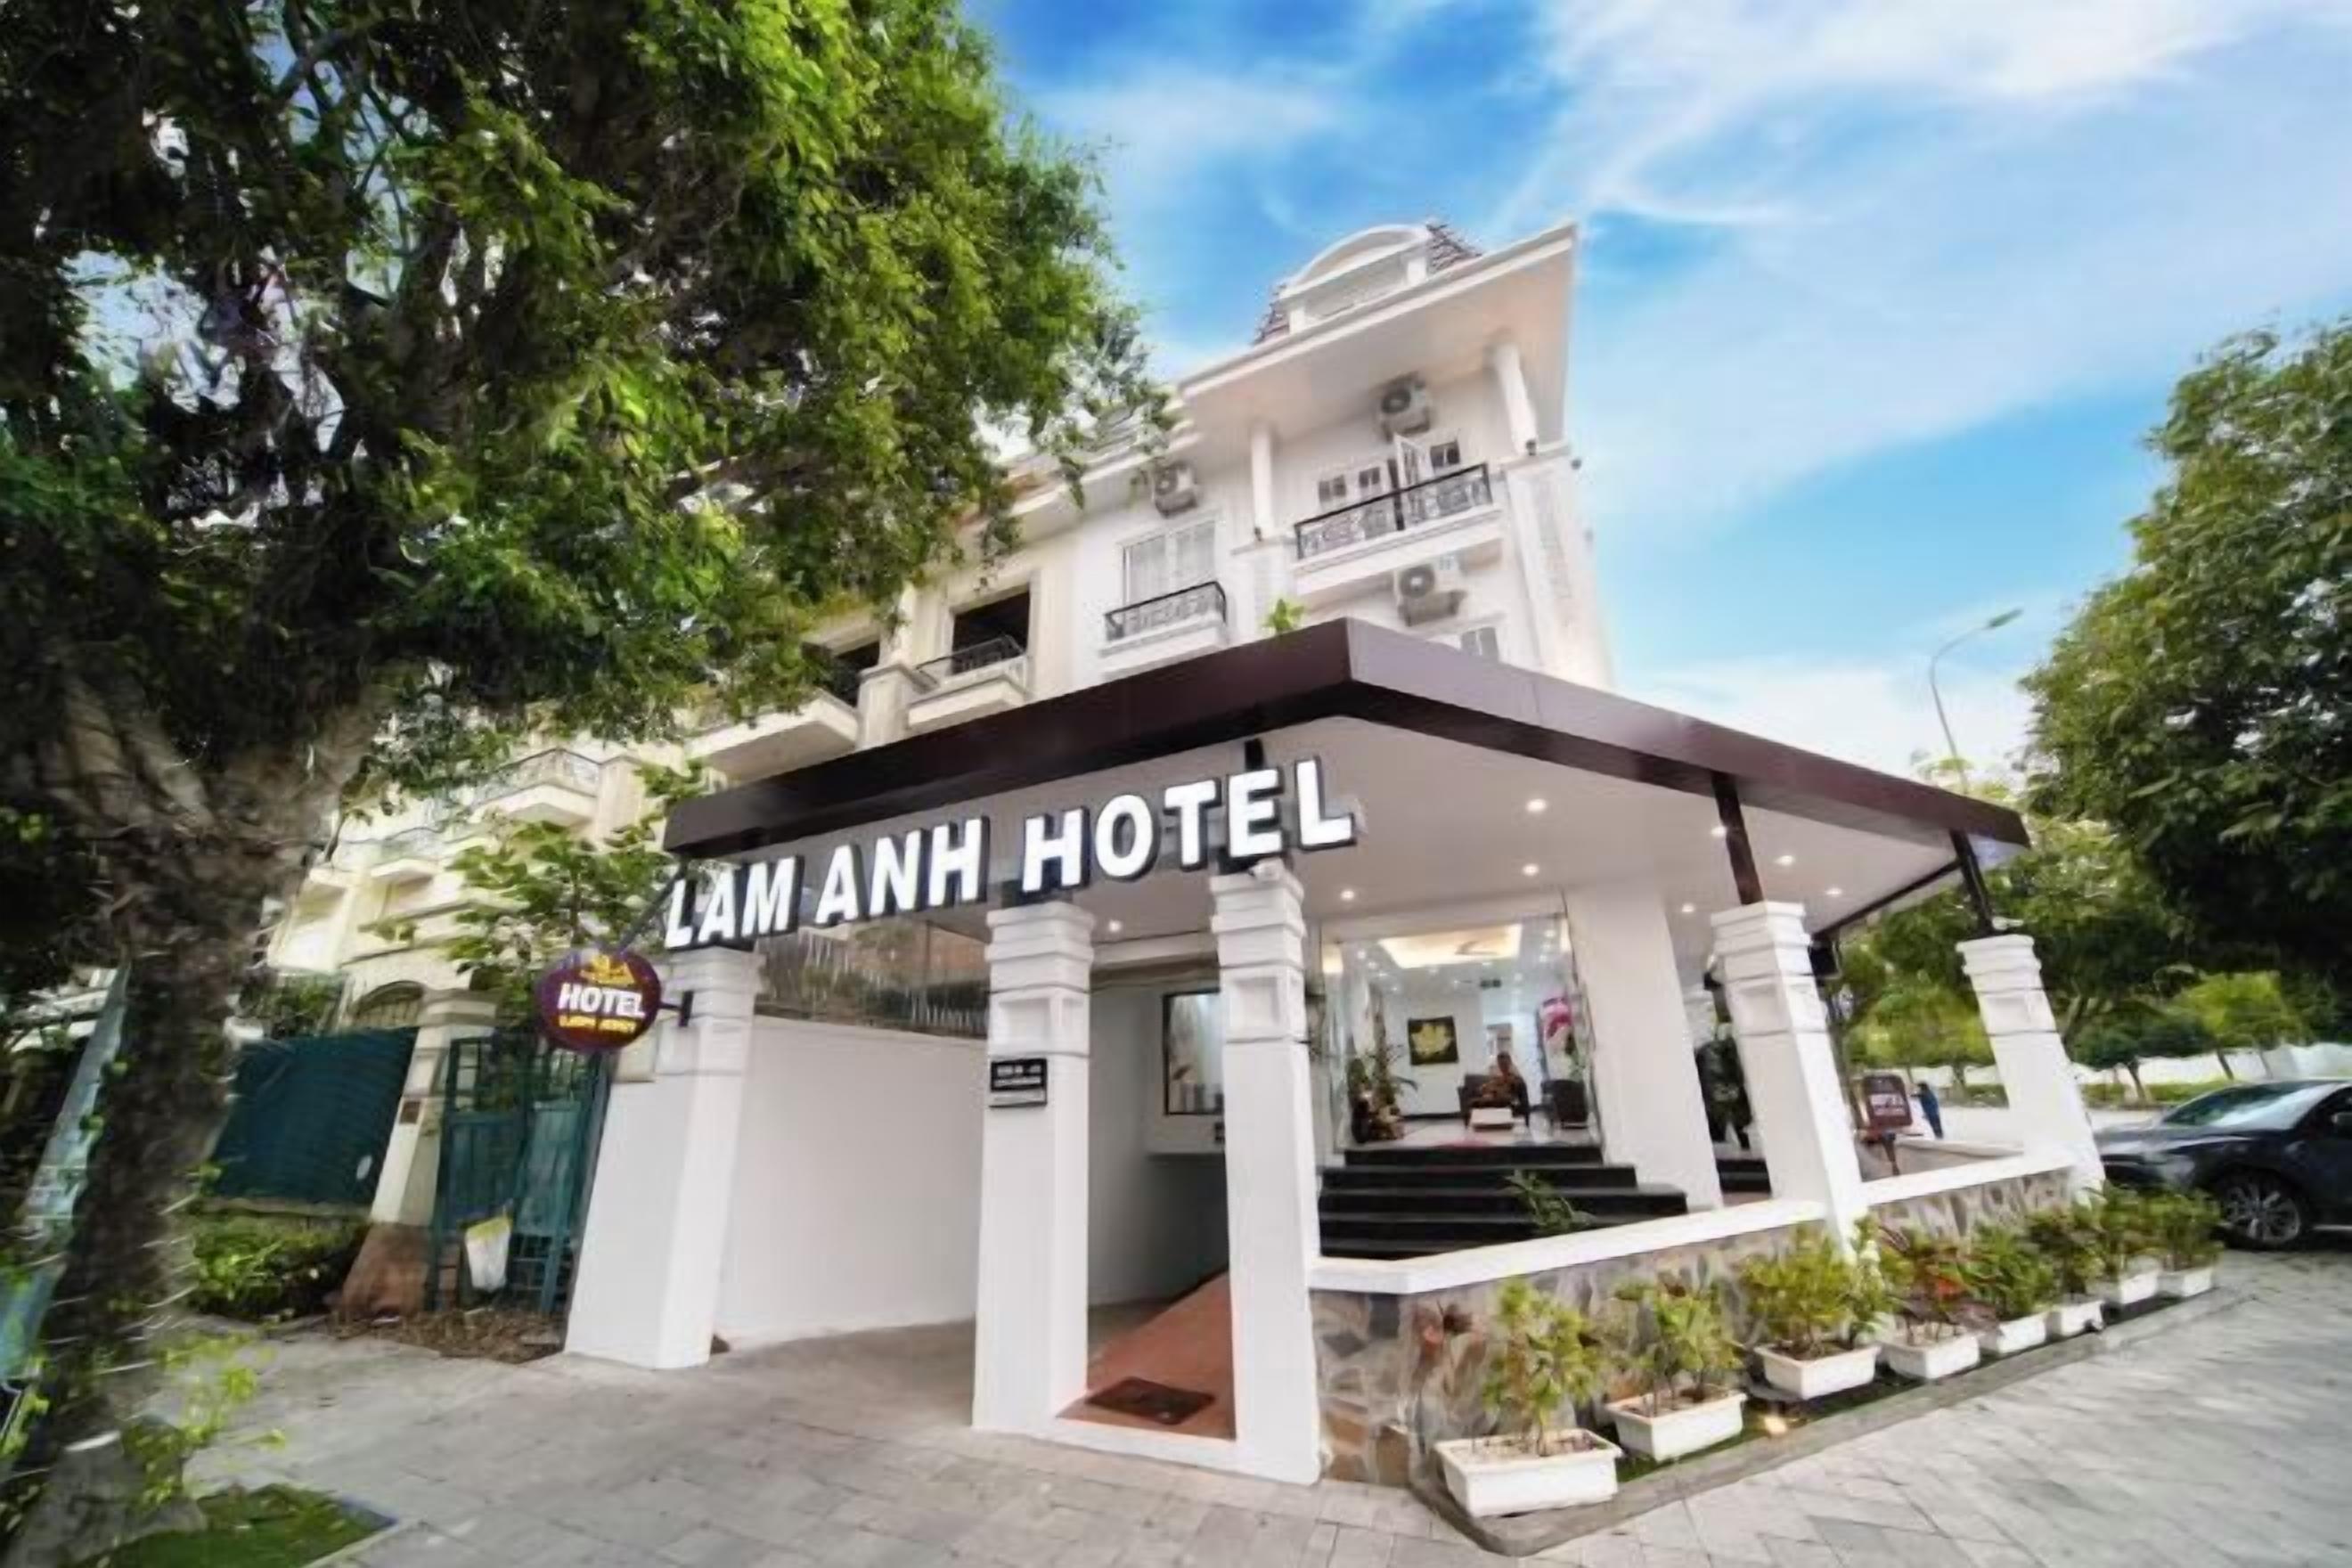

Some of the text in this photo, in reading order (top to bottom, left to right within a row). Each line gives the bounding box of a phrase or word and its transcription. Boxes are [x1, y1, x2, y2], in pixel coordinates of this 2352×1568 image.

[664, 757, 1355, 949] LAM ANH HOTEL
[557, 982, 646, 1019] HOTEL
